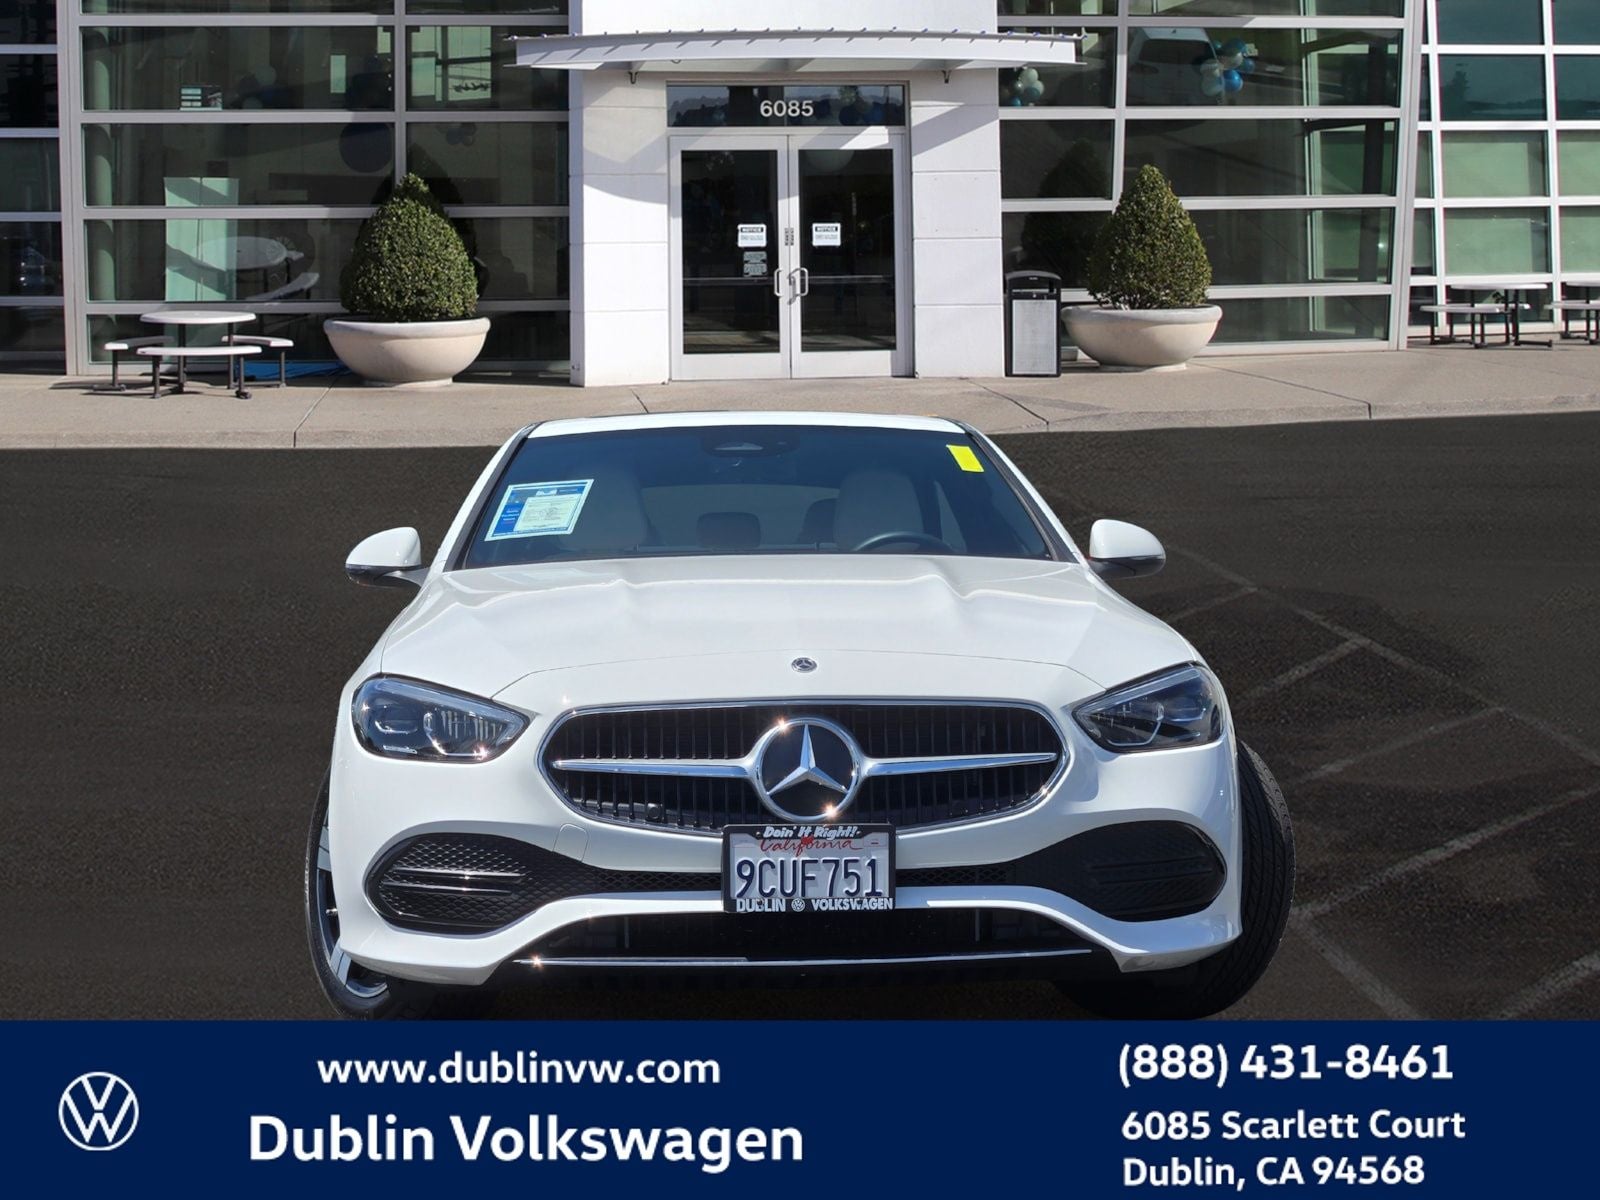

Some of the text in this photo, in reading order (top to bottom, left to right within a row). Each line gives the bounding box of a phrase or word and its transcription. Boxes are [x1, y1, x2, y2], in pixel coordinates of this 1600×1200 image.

[761, 101, 813, 117] 6085
[763, 826, 858, 840] Doin' It Right!
[760, 835, 863, 857] California
[736, 858, 883, 898] 9CUF751
[736, 899, 786, 912] DUBLIN
[811, 897, 893, 911] VOLKSWAGEN
